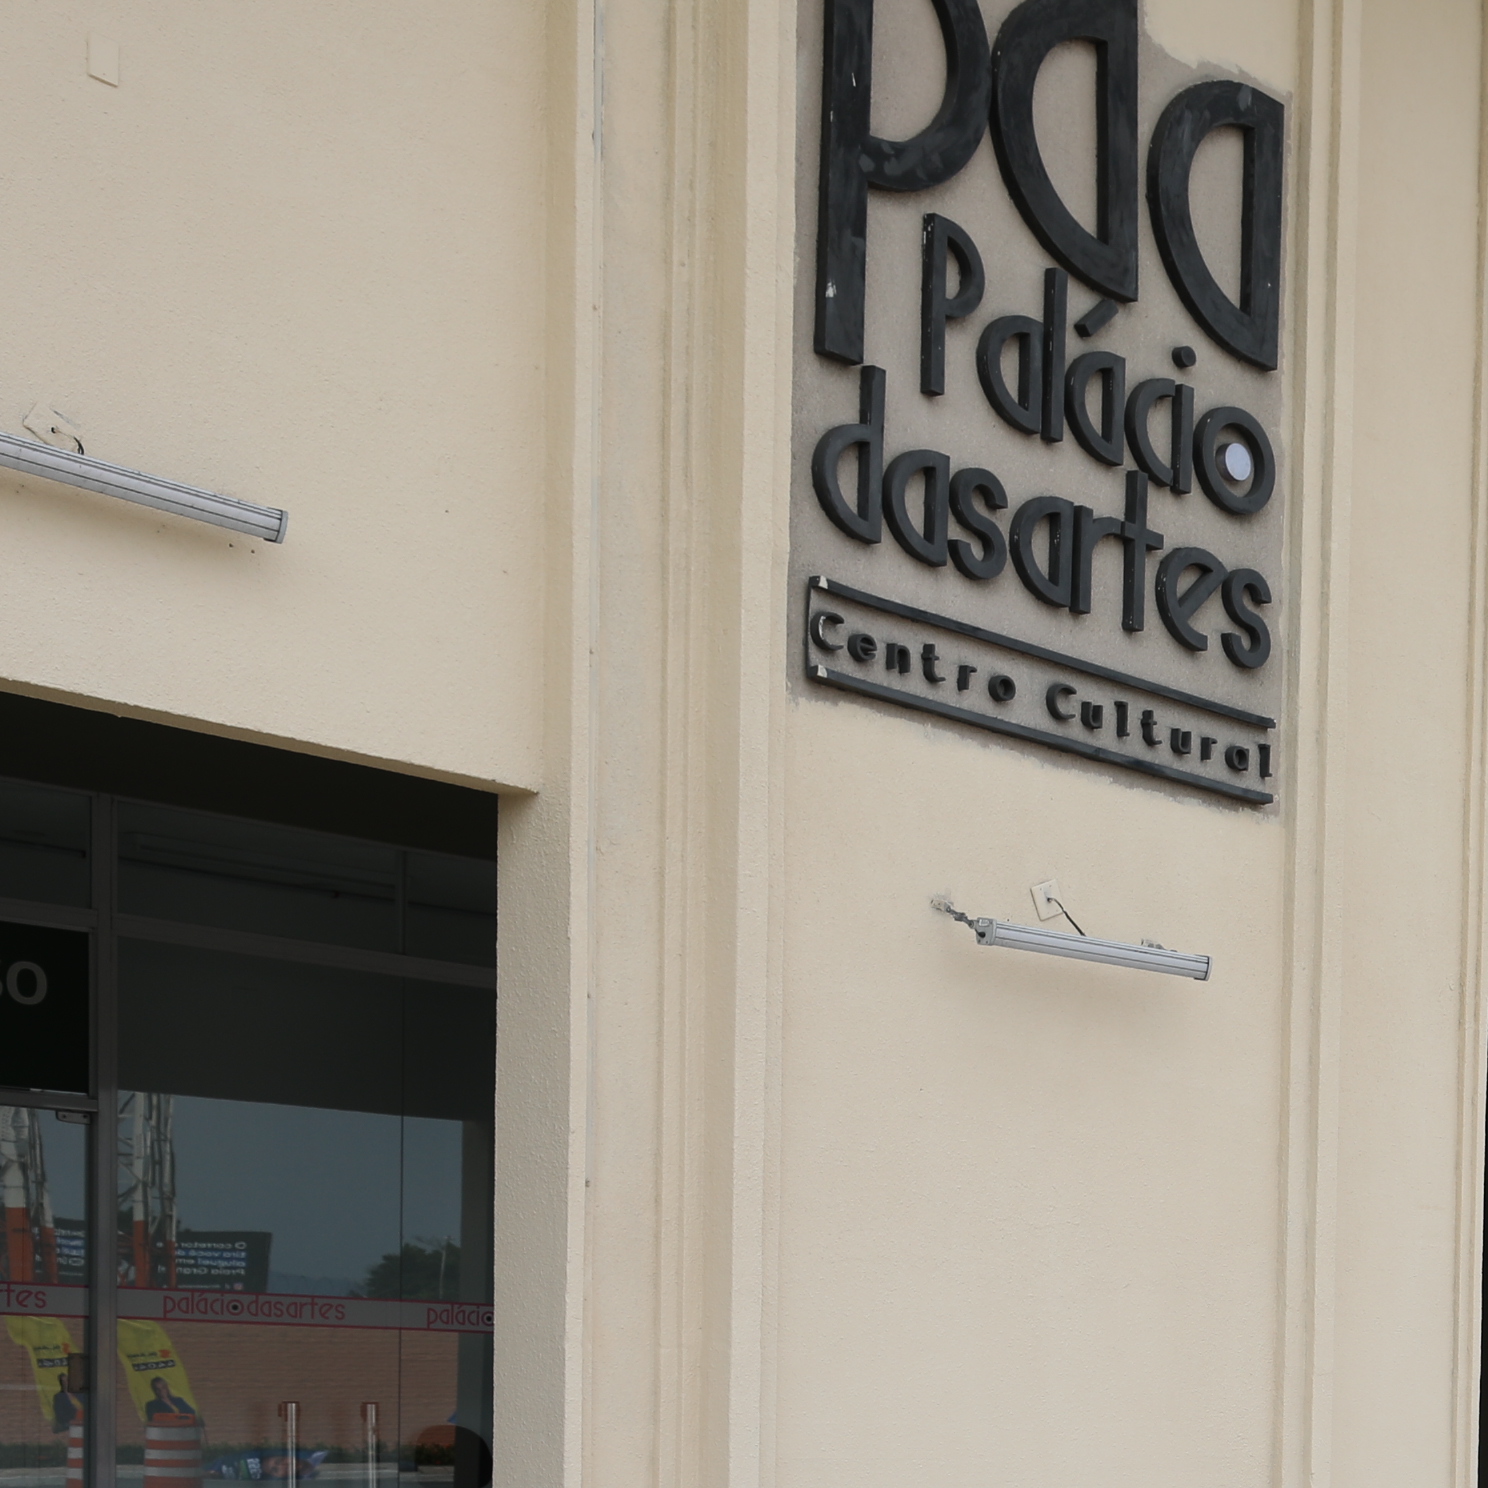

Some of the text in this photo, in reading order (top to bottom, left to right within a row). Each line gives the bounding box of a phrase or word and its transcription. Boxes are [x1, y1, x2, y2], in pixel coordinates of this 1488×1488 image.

[920, 213, 1276, 515] Palácio
[810, 611, 1273, 778] Centro Cultural
